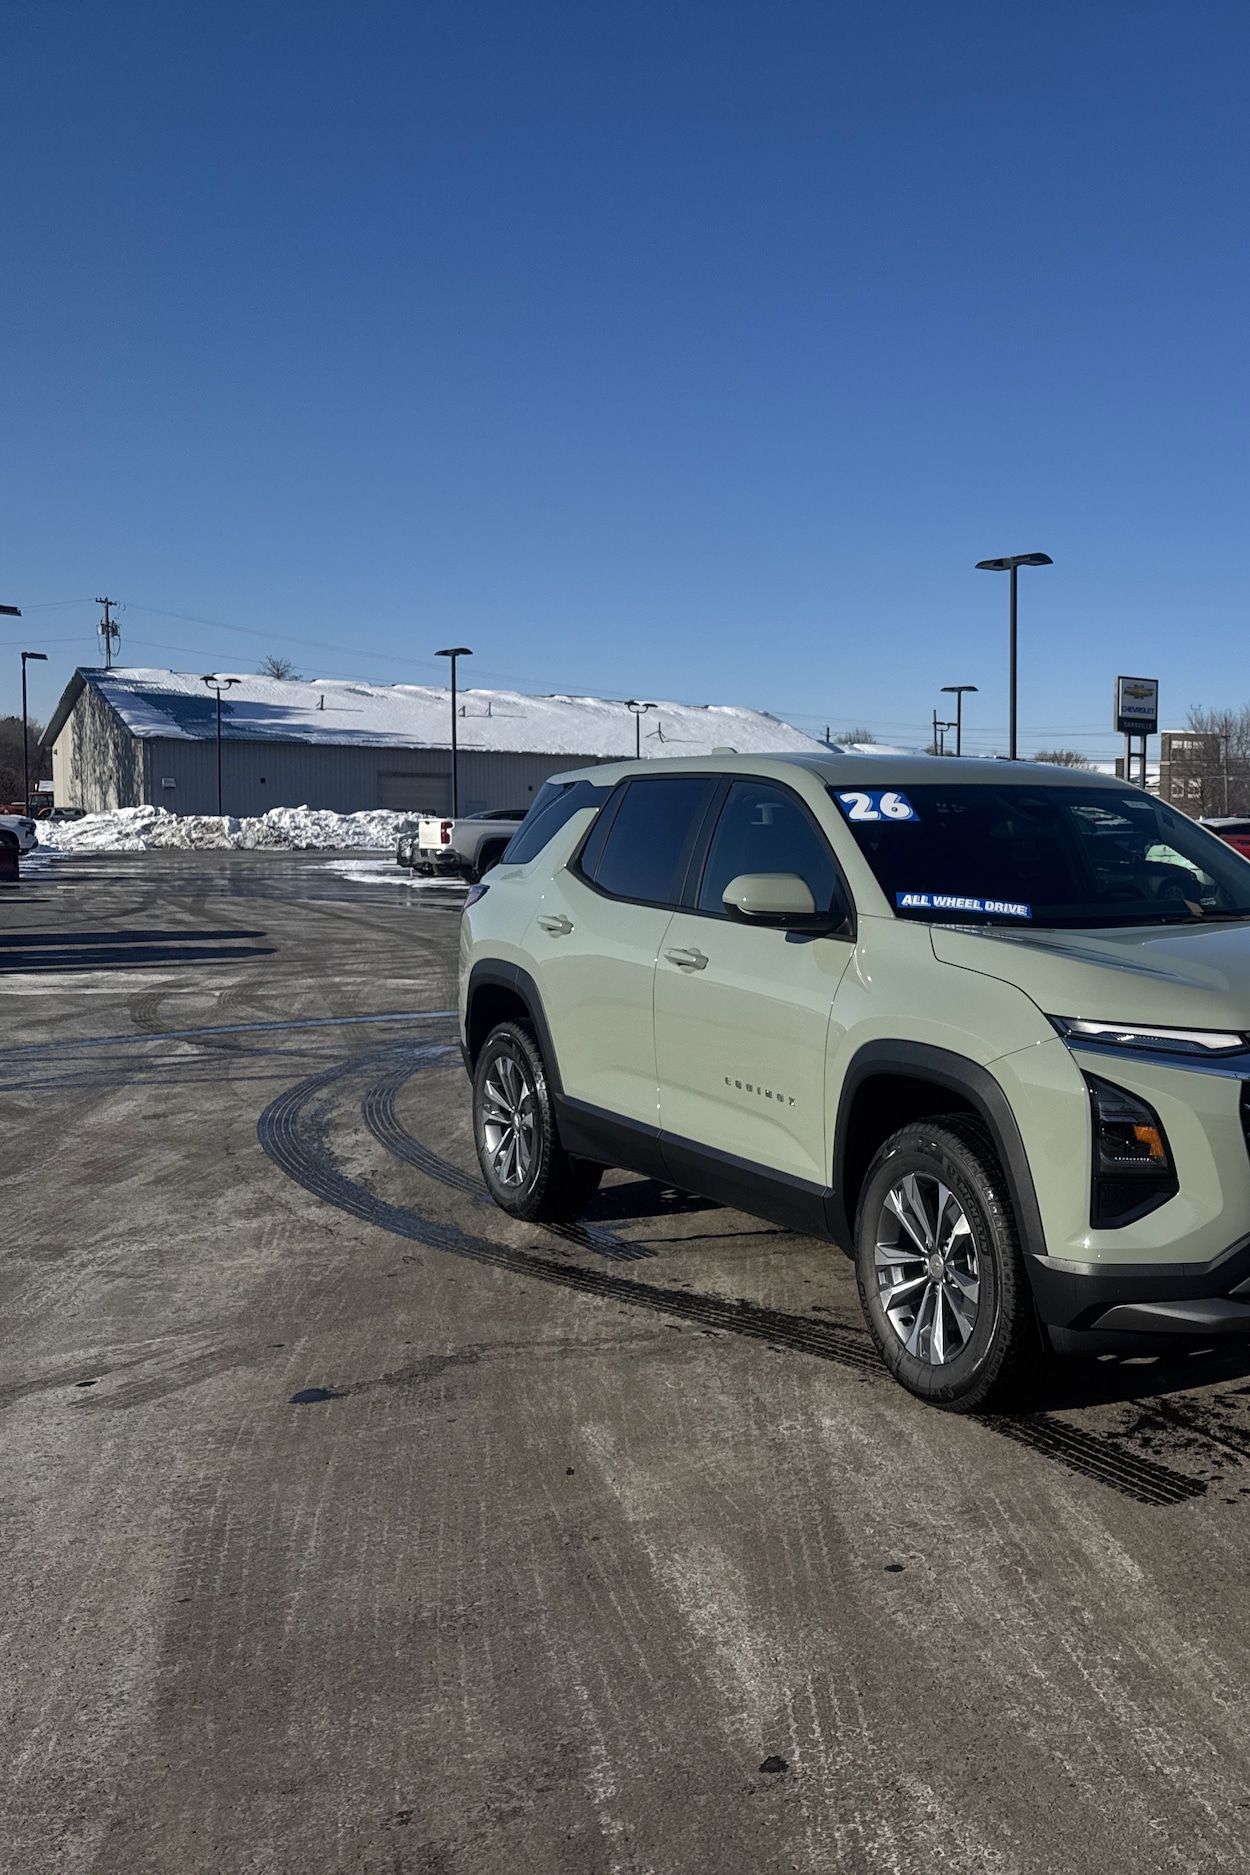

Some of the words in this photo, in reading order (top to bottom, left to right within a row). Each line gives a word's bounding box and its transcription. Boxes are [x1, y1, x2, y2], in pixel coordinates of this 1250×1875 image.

[1121, 706, 1154, 714] CHEVROLET
[1123, 721, 1153, 729] DANSVILLE
[839, 792, 913, 821] 26
[901, 894, 932, 907] ALL
[933, 896, 983, 911] WHEEL
[984, 901, 1028, 916] DRIVE
[957, 1180, 990, 1254] MICHELIN
